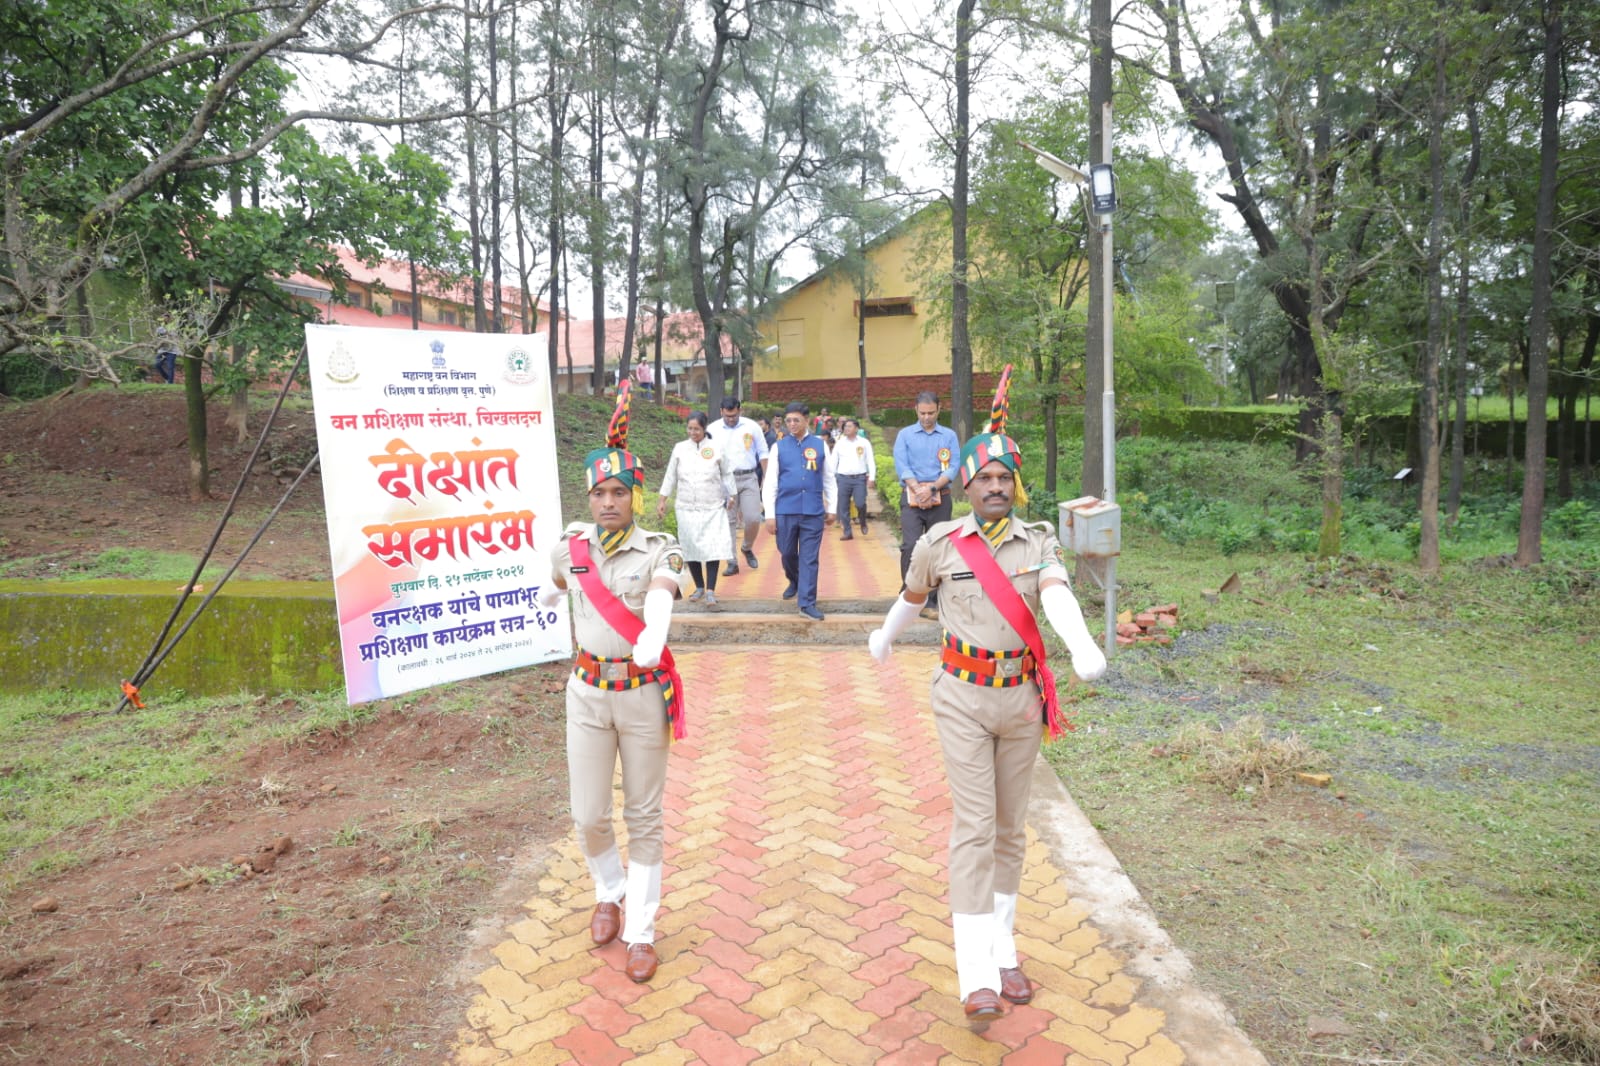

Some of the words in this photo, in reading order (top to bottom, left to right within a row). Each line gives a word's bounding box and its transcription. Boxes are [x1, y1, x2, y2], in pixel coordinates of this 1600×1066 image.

[383, 384, 416, 397] (शिक्षण
[418, 386, 425, 395] व
[427, 384, 459, 397] प्रशिक्षण
[478, 383, 496, 399] पुणे)
[402, 371, 433, 382] महाराष्ट्र
[435, 371, 448, 380] वन
[450, 369, 477, 380] विभाग
[330, 414, 358, 430] वन
[362, 408, 424, 431] प्रशिक्षण
[428, 407, 472, 428] संस्था,
[476, 406, 542, 428] चिखलदरा
[368, 436, 520, 506] दीक्षांत
[361, 500, 538, 568] समारंभ
[391, 579, 425, 599] बुधवार
[427, 575, 442, 589] दि.
[445, 574, 461, 587] २५
[496, 565, 524, 579] २०२४
[372, 601, 443, 628] वनरक्षक
[447, 590, 481, 616] यांचे
[359, 632, 428, 662] प्रशिक्षण
[433, 619, 495, 646] कार्यक्रम
